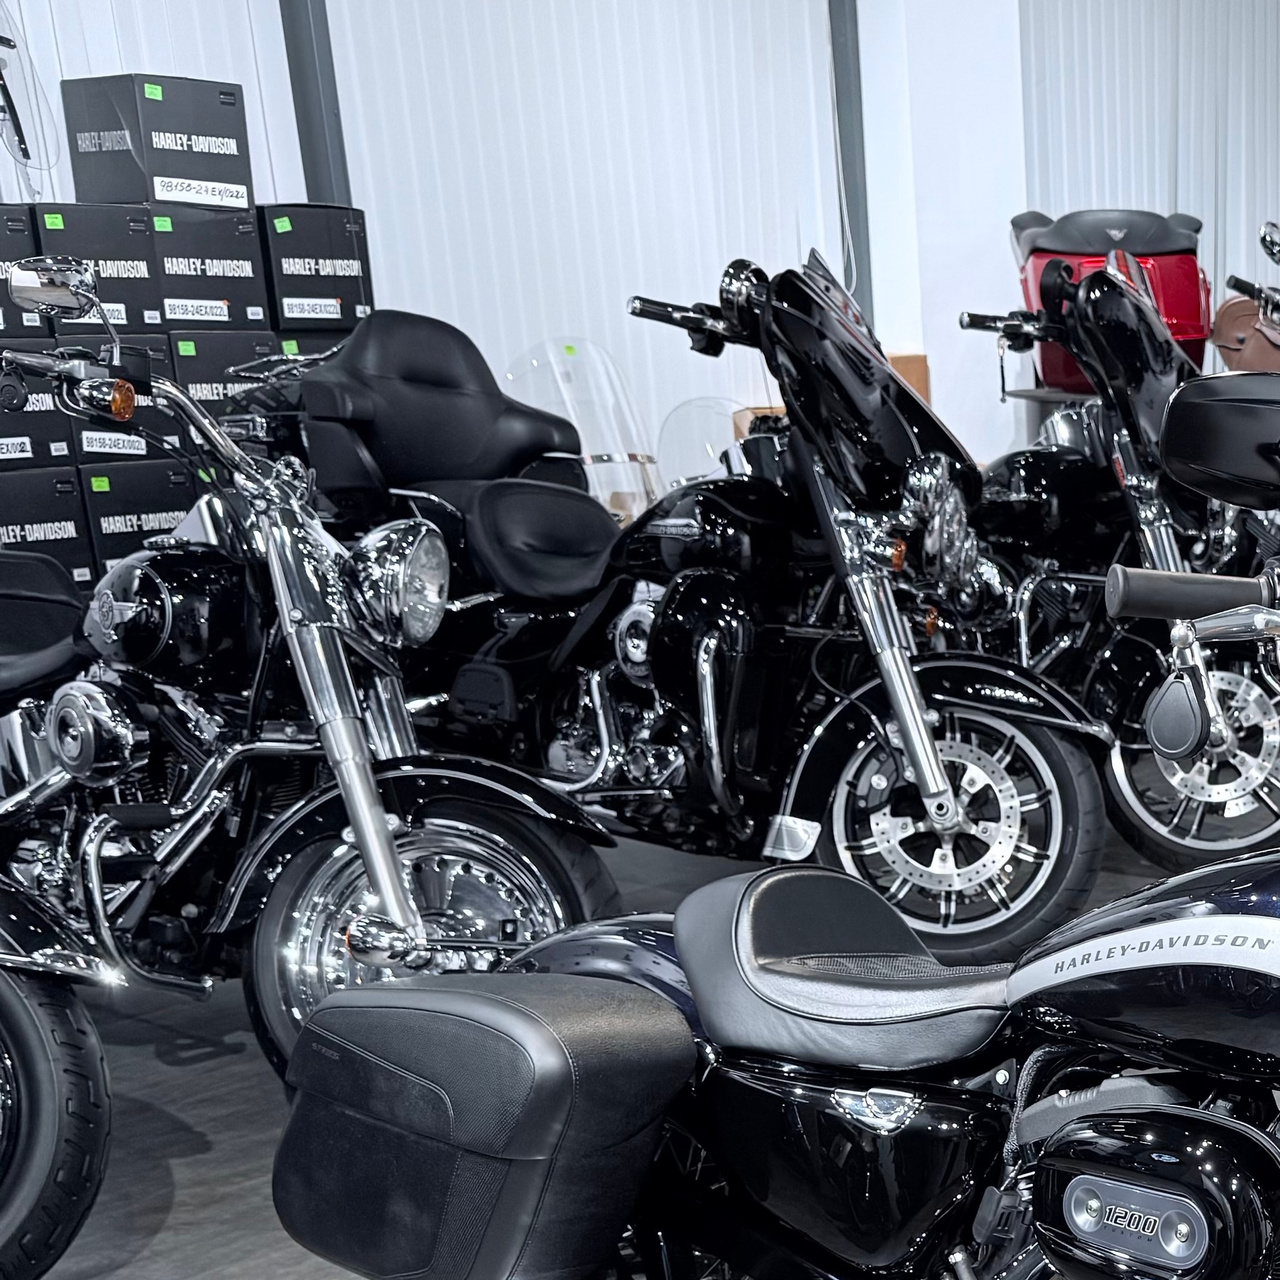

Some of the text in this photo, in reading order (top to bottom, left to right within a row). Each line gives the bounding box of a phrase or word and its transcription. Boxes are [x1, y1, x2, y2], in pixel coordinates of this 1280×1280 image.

[151, 131, 239, 155] HARLEY-DAVIDSON
[164, 257, 254, 277] HARLEY-DAVIDSON
[281, 258, 363, 276] HARLEY-DAVIDSON
[1054, 934, 1271, 974] HARLEY-DAVIDSON
[1104, 1205, 1159, 1236] 1200
